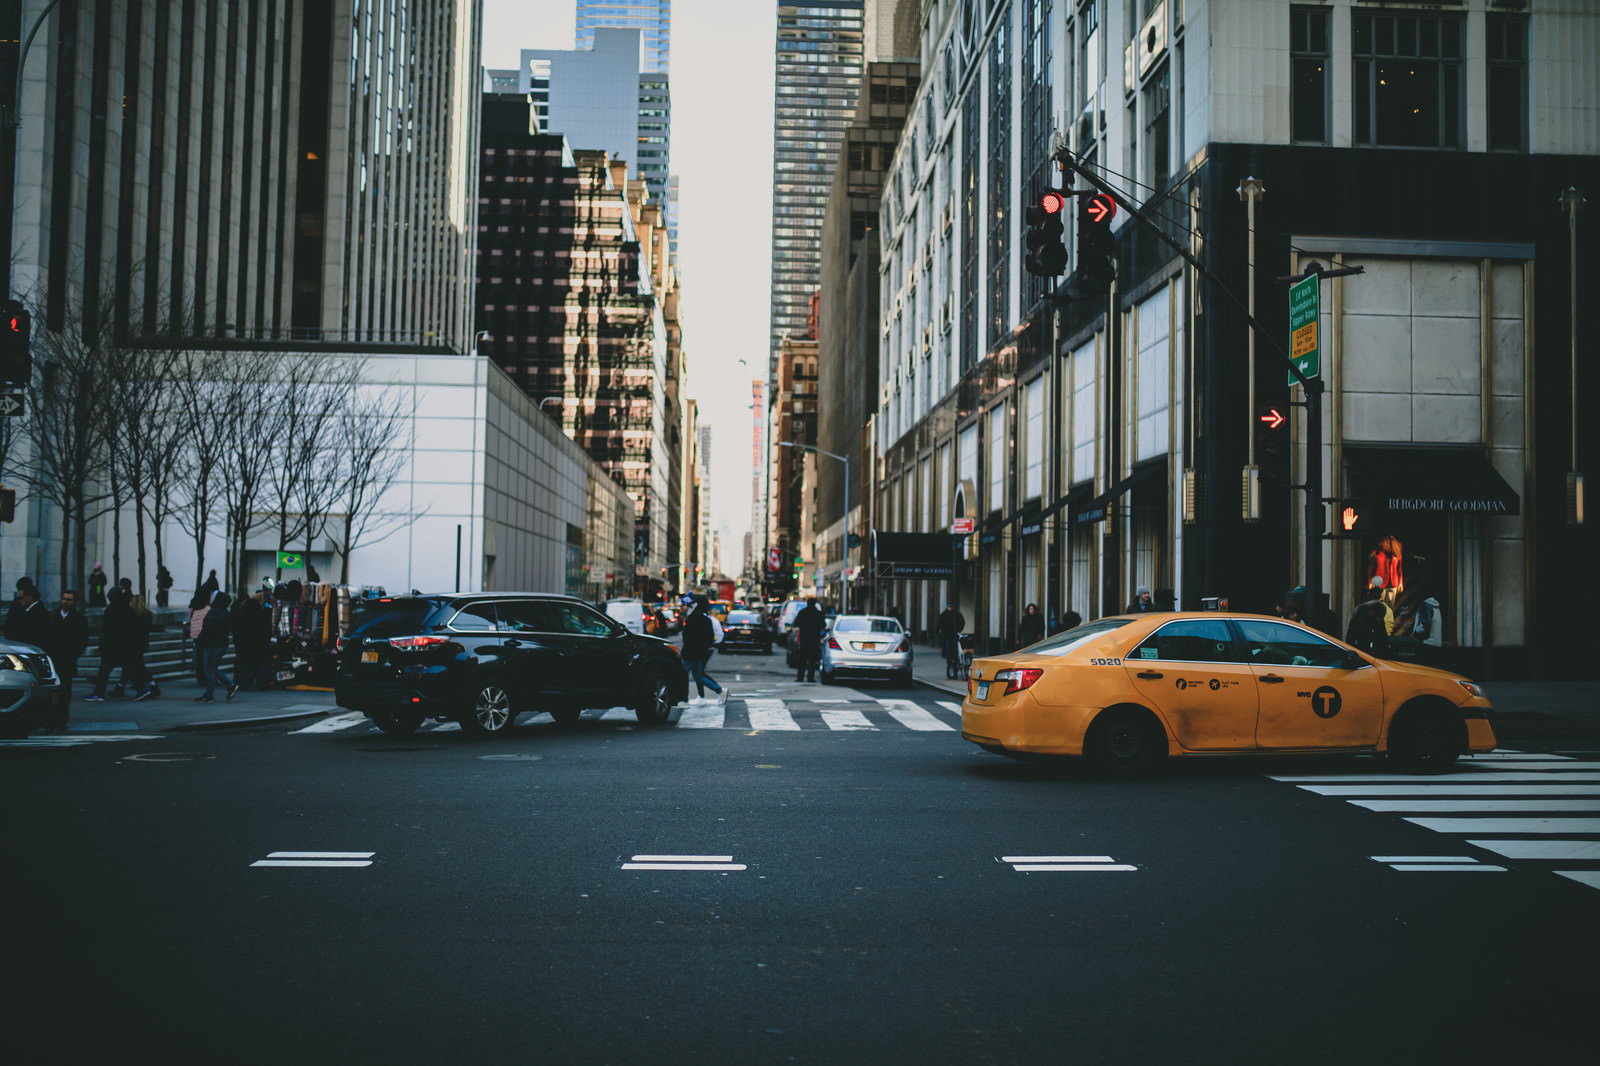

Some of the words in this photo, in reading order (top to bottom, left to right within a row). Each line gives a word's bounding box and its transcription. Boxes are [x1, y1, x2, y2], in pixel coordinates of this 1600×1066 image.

[0, 400, 14, 410] AY
[1388, 498, 1444, 510] BERGDORF
[1449, 500, 1507, 511] GOODMAN
[1090, 658, 1122, 666] 5D20
